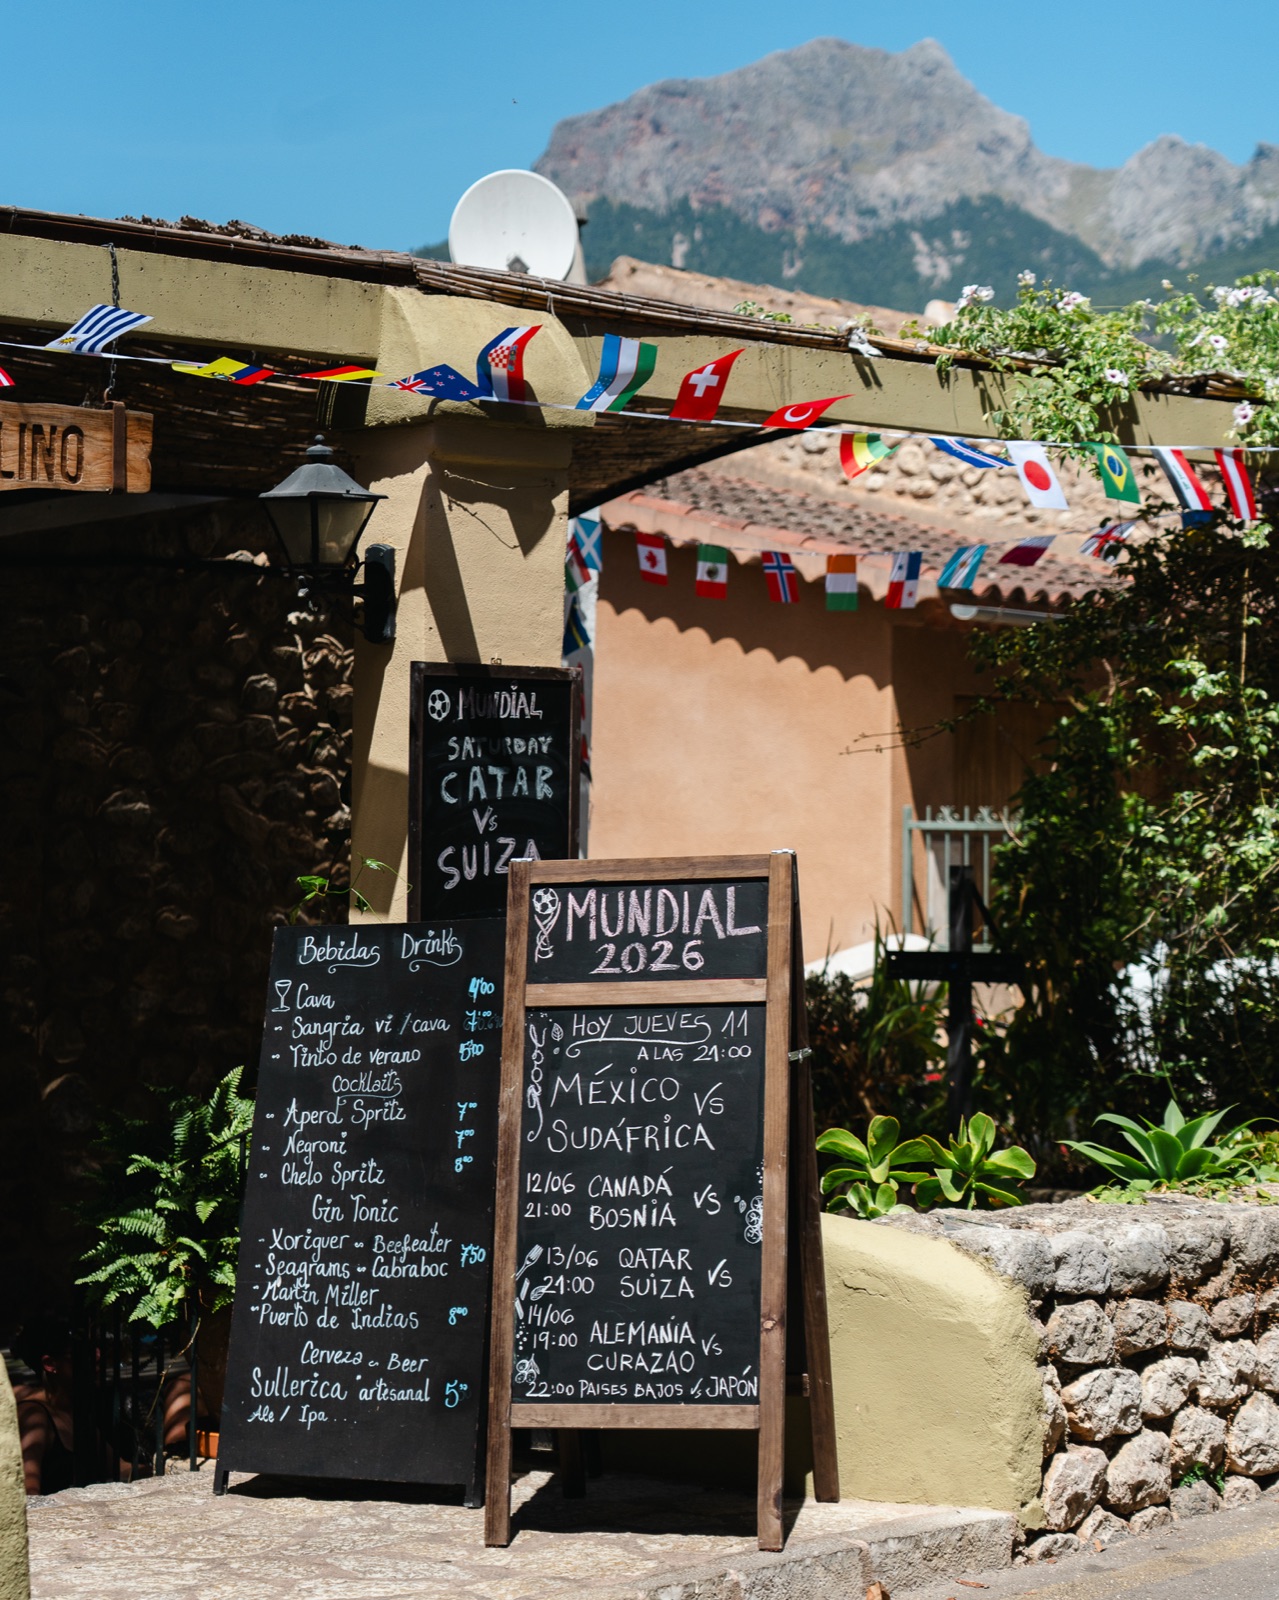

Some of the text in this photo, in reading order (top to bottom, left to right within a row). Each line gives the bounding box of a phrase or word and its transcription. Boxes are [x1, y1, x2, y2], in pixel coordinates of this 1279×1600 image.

[448, 736, 552, 760] SATURDAY
[440, 765, 553, 804] CATAR
[566, 886, 762, 942] MUNDIAL
[298, 928, 463, 970] Bebidas Drinks
[589, 940, 705, 975] 2026
[296, 983, 335, 1009] Cava
[292, 1015, 365, 1050] Sangria
[375, 1014, 393, 1033] vi
[624, 1012, 711, 1038] JUEVES
[721, 1010, 748, 1037] 11
[290, 1040, 337, 1067] Tinto
[342, 1046, 362, 1065] de
[369, 1048, 421, 1066] verano
[637, 1045, 752, 1062] A LAS 21:00
[351, 1099, 406, 1130] Spritz
[283, 1130, 347, 1164] Negroni
[281, 1162, 322, 1185] Chelo
[331, 1158, 385, 1190] Spritz
[526, 1171, 576, 1195] 12/06
[588, 1165, 673, 1198] CANADÁ
[312, 1194, 399, 1223] Gin Tonic
[524, 1202, 571, 1218] 21:00
[268, 1227, 350, 1262] Xoriguer
[372, 1222, 452, 1262] Beefeater
[547, 1243, 599, 1270] 13/06
[618, 1247, 693, 1270] QATAR
[265, 1253, 449, 1287] Seagrams Cabraboc
[262, 1278, 380, 1307] Martin Miller
[542, 1275, 595, 1295] 21:00
[259, 1302, 308, 1329] Puerto
[317, 1306, 339, 1329] de
[351, 1304, 419, 1330] Indias
[527, 1303, 575, 1328] 14/06
[533, 1332, 578, 1350] 19:00
[300, 1340, 429, 1372] Cerveza Beer
[587, 1350, 695, 1375] CURAZAO
[251, 1366, 348, 1400] Sullerica
[358, 1378, 430, 1402] artesanal
[525, 1381, 575, 1398] 22:00
[578, 1379, 628, 1398] PAISES
[633, 1383, 683, 1399] BAJOS
[705, 1365, 758, 1398] JAPÓN
[247, 1405, 275, 1423] Ale
